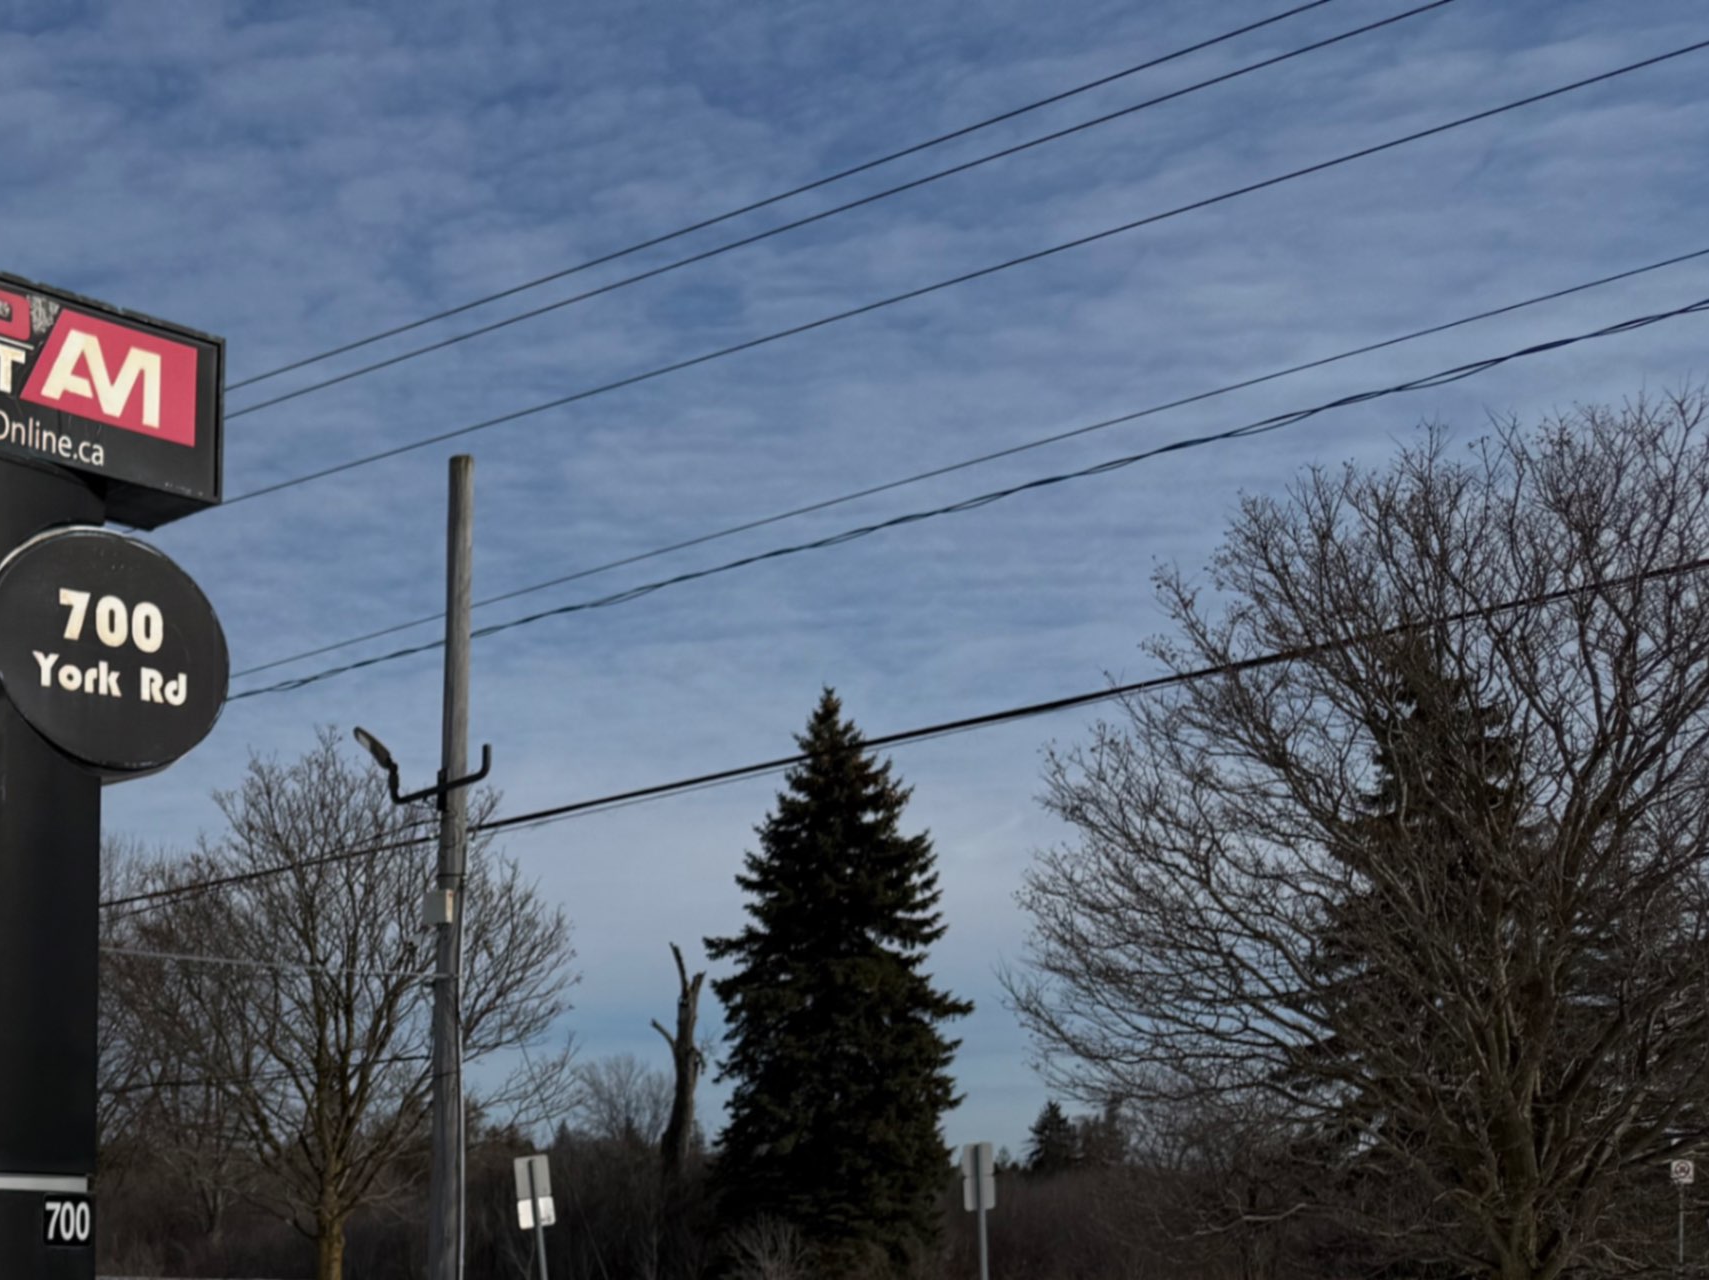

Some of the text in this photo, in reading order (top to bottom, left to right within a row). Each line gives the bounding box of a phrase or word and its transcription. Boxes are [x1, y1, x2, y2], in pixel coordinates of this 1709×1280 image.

[39, 328, 162, 429] AM
[58, 587, 164, 654] 700
[32, 649, 188, 707] York Rd
[44, 1201, 90, 1241] 700
